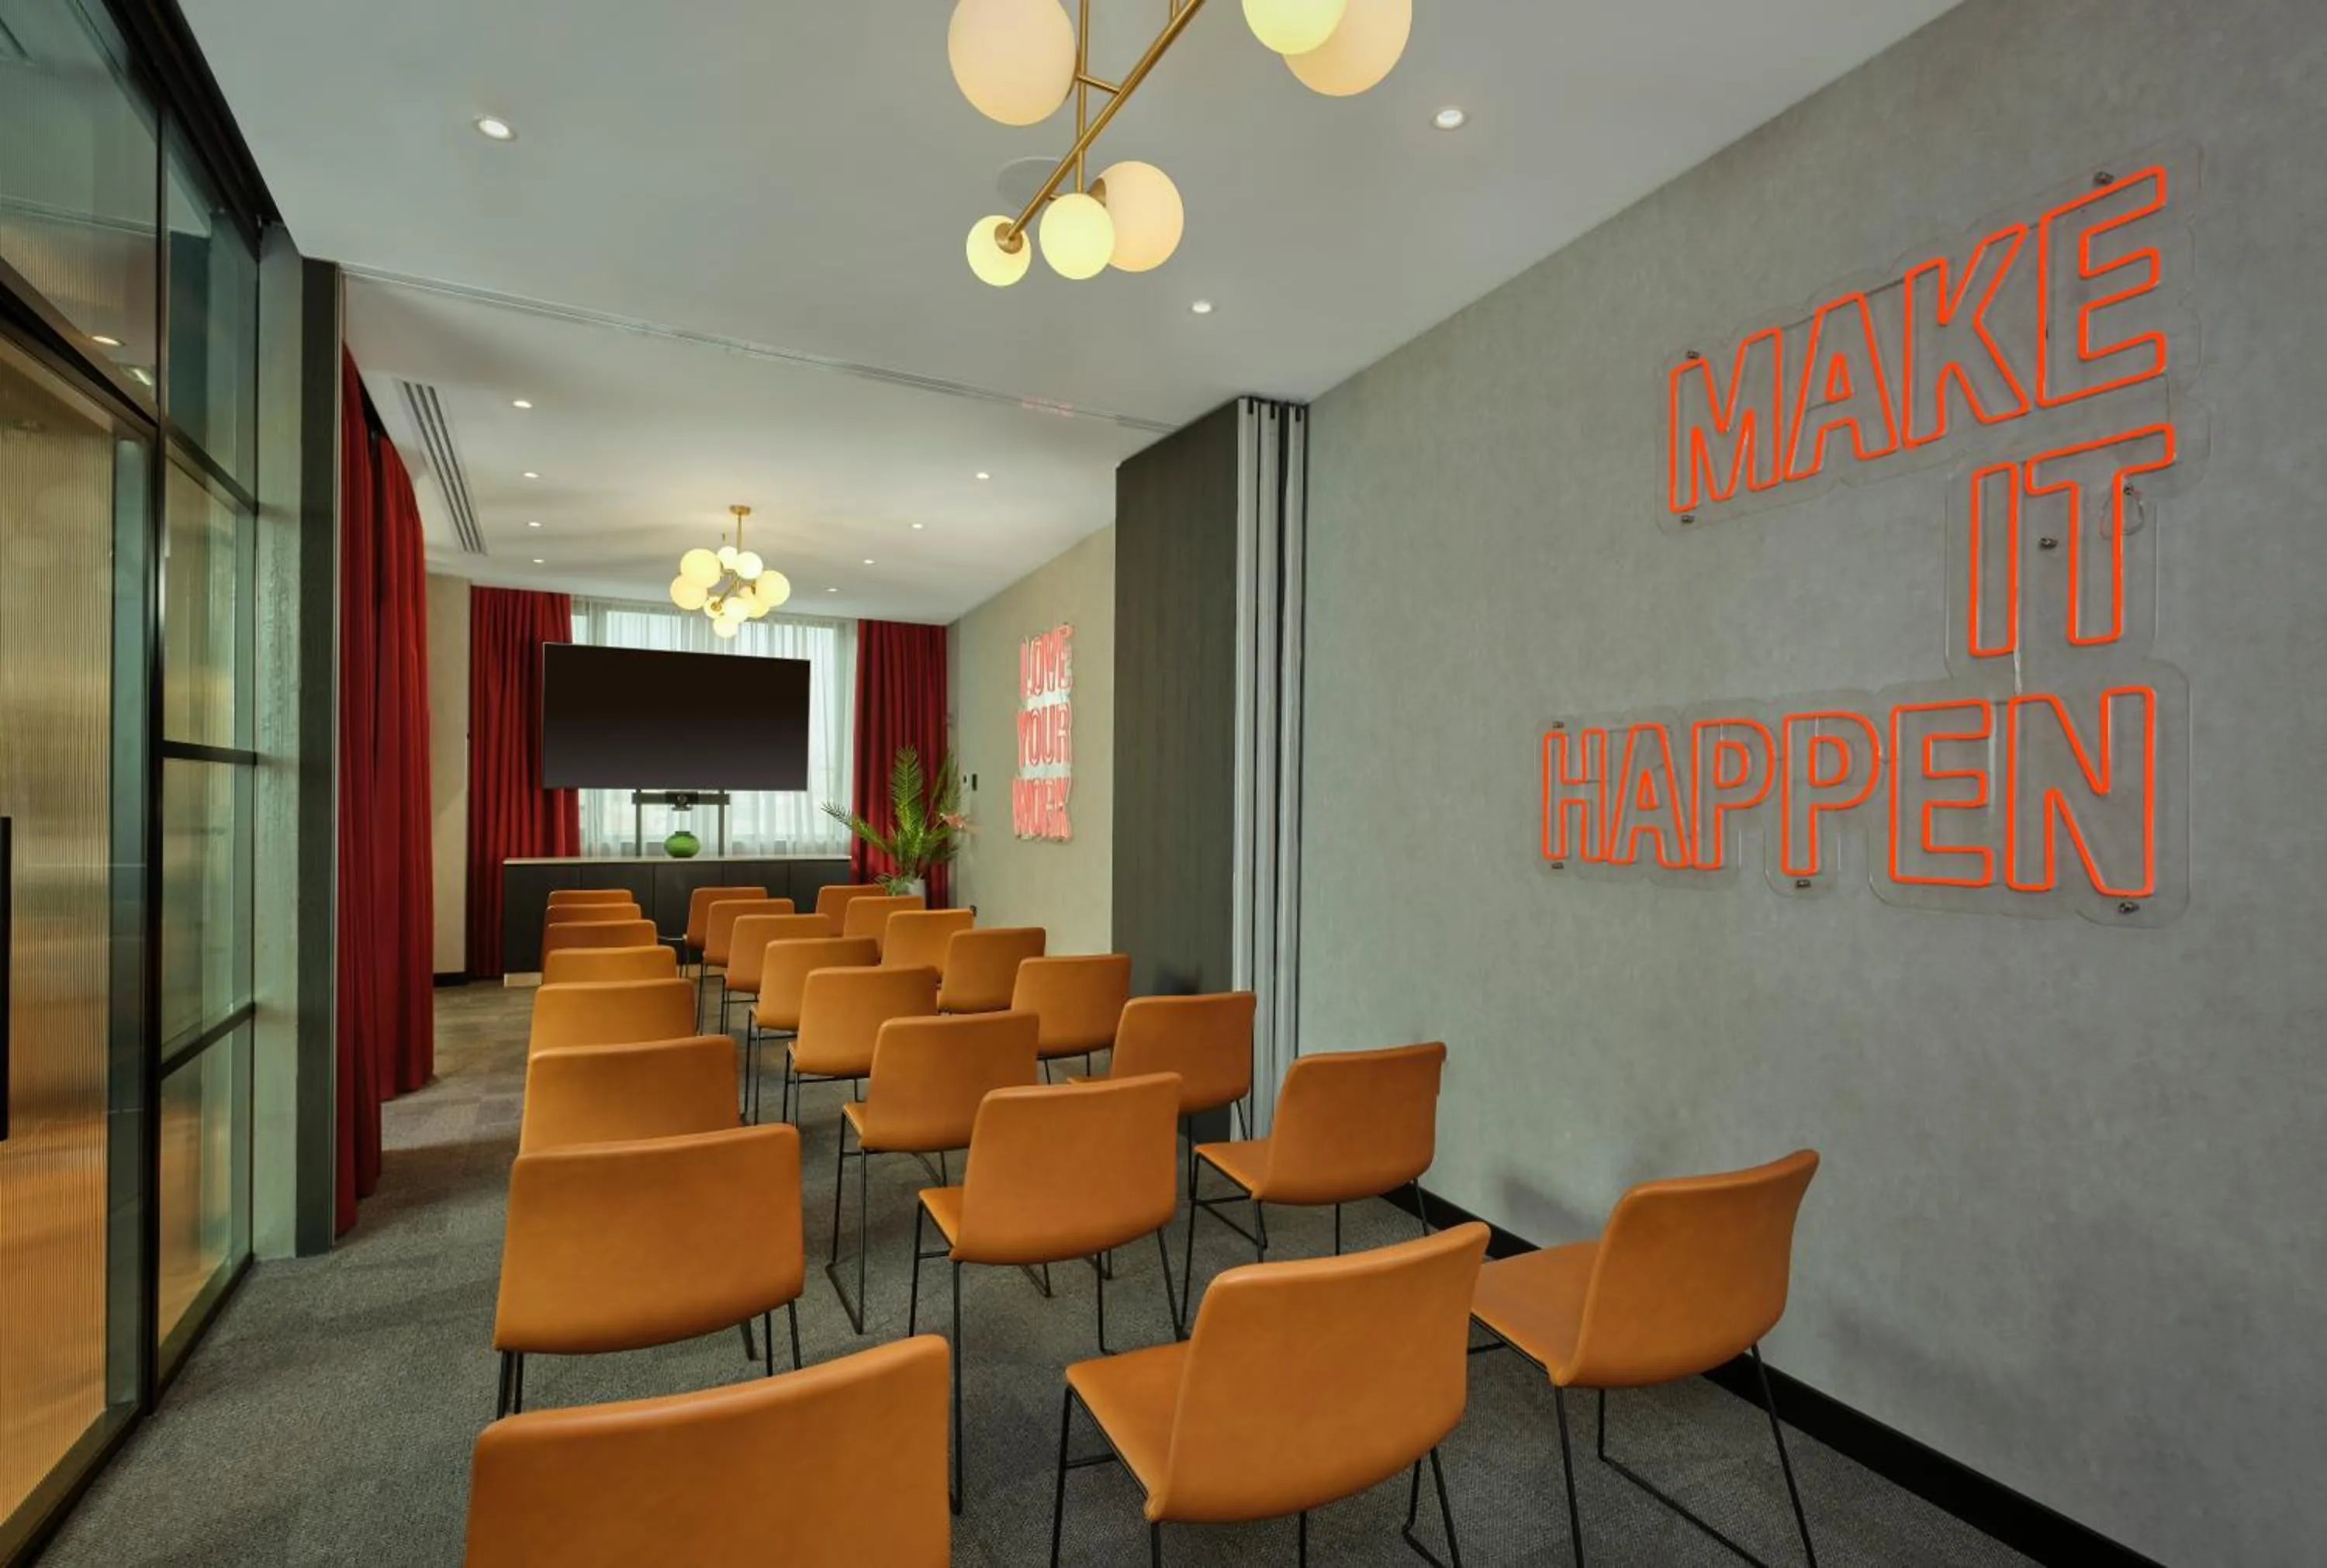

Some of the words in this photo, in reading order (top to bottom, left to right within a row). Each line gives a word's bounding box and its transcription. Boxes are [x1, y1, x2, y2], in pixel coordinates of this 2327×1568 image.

[1669, 165, 2166, 513] MAKE
[1968, 423, 2175, 656] IT
[1019, 625, 1074, 699] LOVE
[1017, 703, 1072, 768] YOUR
[1542, 686, 2155, 896] HAPPEN
[1011, 776, 1071, 838] WORK
